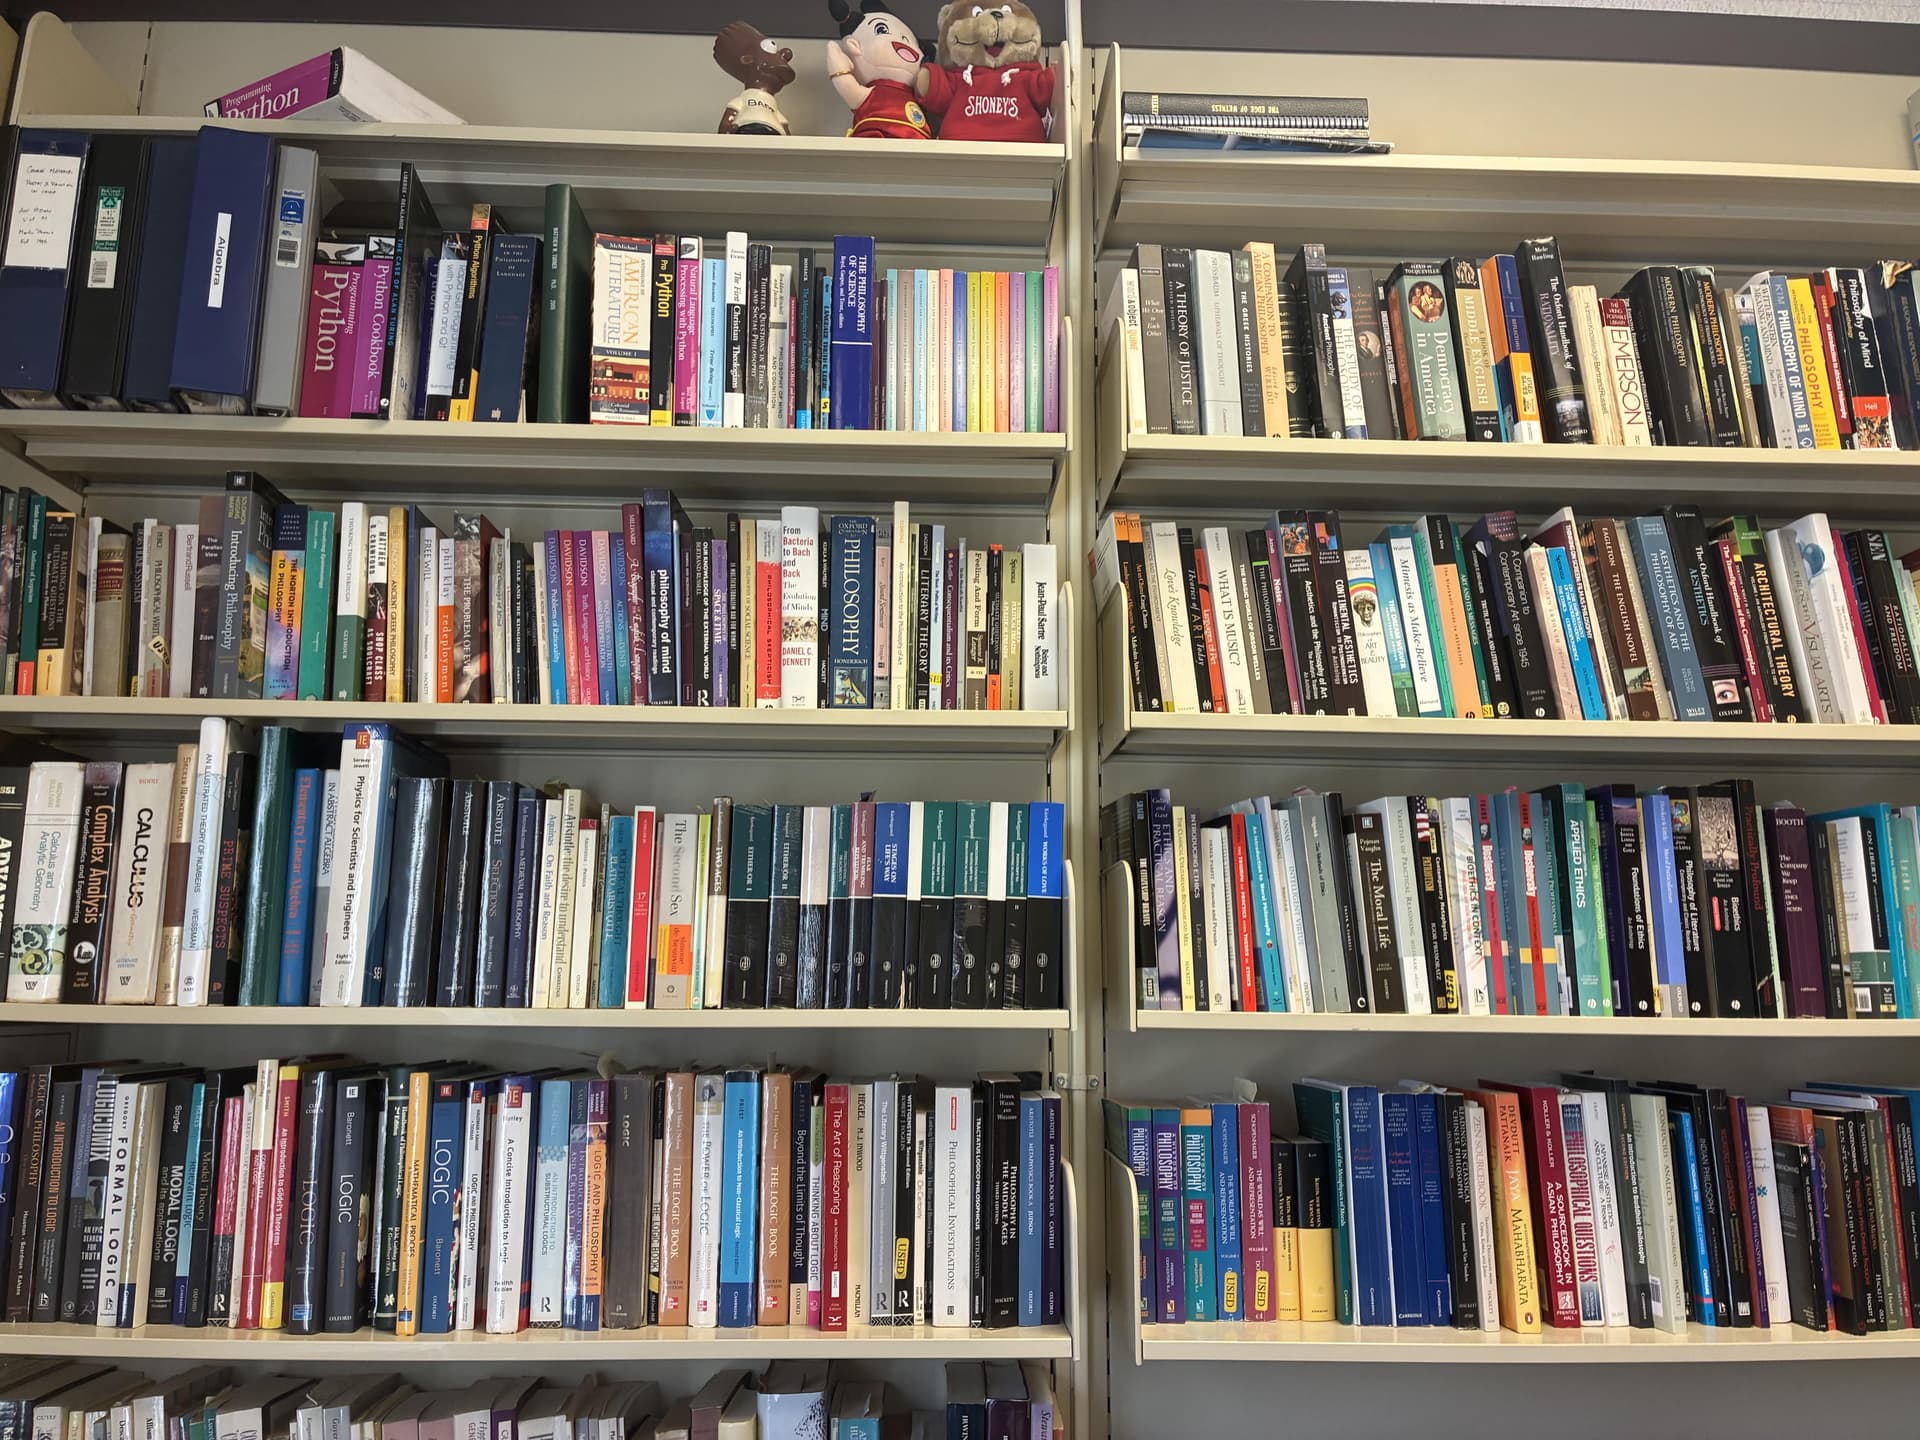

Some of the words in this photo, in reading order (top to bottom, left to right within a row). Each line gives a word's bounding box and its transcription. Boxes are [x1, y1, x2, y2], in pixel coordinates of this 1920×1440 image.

[226, 82, 272, 108] Programming
[965, 95, 1018, 118] SHONEY'S
[1212, 104, 1238, 113] WETNESS
[1239, 105, 1248, 113] OF
[1250, 106, 1266, 114] EDGE
[1267, 106, 1280, 114] THE
[212, 236, 226, 286] Algebra
[473, 235, 483, 259] Python
[848, 255, 856, 268] OF
[858, 255, 866, 274] THE
[394, 256, 402, 276] CASE
[468, 260, 480, 299] Algorithms
[660, 260, 668, 270] Pro
[689, 265, 698, 295] Natural
[374, 264, 390, 310] Python
[392, 279, 400, 289] OF
[607, 254, 622, 344] LITERATURE
[623, 255, 639, 344] AMERICAN
[656, 273, 672, 317] Python
[678, 264, 688, 309] Processing
[847, 270, 856, 307] SCIENCE
[1175, 281, 1185, 289] A
[1550, 277, 1559, 292] The
[345, 271, 360, 335] Programming
[390, 292, 399, 313] ALAN
[688, 297, 697, 335] Language
[857, 276, 866, 333] PHILOSOPHY
[1176, 292, 1188, 338] THEORY
[1553, 294, 1564, 319] Oxford
[1848, 279, 1865, 329] Philosophy
[314, 270, 349, 372] Python
[388, 317, 396, 346] TURING
[679, 311, 687, 330] with
[732, 305, 741, 340] Christian
[1540, 293, 1559, 357] RATIONALITY
[1858, 331, 1867, 341] of
[367, 313, 384, 379] Cookbook
[678, 331, 686, 360] Python
[1179, 341, 1189, 358] OF
[1416, 333, 1428, 347] in
[1464, 295, 1482, 344] MIDDLE
[1473, 349, 1488, 405] ENGLISH
[1558, 321, 1572, 359] Handbook
[1777, 309, 1799, 372] PHILOSOPHY
[1861, 342, 1873, 368] Mind
[731, 345, 740, 388] Theologians
[1178, 360, 1192, 406] JUSTICE
[1419, 352, 1438, 415] America
[1433, 331, 1456, 415] Democracy
[1564, 362, 1575, 371] of
[1611, 329, 1643, 425] EMERSON
[1789, 376, 1802, 388] OF
[1798, 328, 1823, 409] PHILOSOPHY
[1791, 392, 1806, 418] MIND
[783, 526, 801, 535] From
[783, 537, 814, 545] Bacteria
[1601, 527, 1616, 566] EAGLETON
[225, 530, 242, 591] Introducing
[278, 559, 285, 568] TO
[289, 559, 298, 573] THE
[441, 548, 454, 570] phil
[578, 539, 588, 586] DAVIDSON
[783, 548, 791, 556] to
[792, 547, 811, 556] Bach
[783, 558, 796, 567] and
[973, 552, 982, 582] Feeling
[441, 576, 453, 599] klay
[783, 568, 800, 578] Back
[1164, 568, 1178, 594] Love's
[1217, 570, 1232, 607] WHAT
[1399, 559, 1413, 600] Mimesis
[1611, 573, 1622, 591] THE
[275, 573, 284, 623] PHILOSOPHY
[287, 575, 297, 608] NORTON
[657, 570, 670, 630] philosophy
[841, 538, 860, 656] PHILOSOPHY
[920, 570, 930, 622] LITERARY
[1035, 581, 1047, 616] Jean-Paul
[1407, 602, 1415, 614] as
[220, 592, 239, 650] Philosophy
[1038, 617, 1046, 640] Sartre
[1168, 596, 1184, 647] Knowledge
[1222, 609, 1234, 620] IS
[1615, 592, 1631, 631] ENGLISH
[283, 610, 295, 671] INTRODUCTION
[660, 632, 671, 644] of
[1224, 622, 1240, 666] MUSIC?
[1753, 562, 1784, 650] ARCHITECTURAL
[1774, 654, 1795, 697] THEORY
[440, 615, 451, 694] redeployment
[661, 646, 671, 673] mind
[782, 647, 806, 656] DANIEL
[807, 647, 813, 655] C.
[782, 657, 811, 666] DENNETT
[919, 627, 928, 674] THEORY
[1409, 615, 1428, 683] Make-Believe
[1625, 633, 1638, 664] NOVEL
[353, 776, 366, 808] Physics
[90, 804, 115, 862] Complex
[353, 811, 362, 825] for
[674, 820, 687, 844] The
[36, 831, 49, 866] Analytic
[46, 831, 62, 868] Calculus
[348, 827, 361, 870] Scientists
[1569, 820, 1583, 865] APPLIED
[45, 871, 56, 889] and
[347, 873, 357, 891] and
[671, 846, 684, 892] Second
[1369, 859, 1383, 883] The
[30, 868, 46, 912] Geometry
[84, 868, 107, 924] Analysis
[669, 894, 682, 917] Sex
[1373, 885, 1386, 922] Moral
[1575, 868, 1586, 908] ETHICS
[342, 893, 355, 940] Engineers
[1377, 926, 1391, 949] Life
[345, 1112, 355, 1145] Baronett
[832, 1109, 842, 1129] The
[795, 1129, 806, 1164] Beyond
[832, 1147, 843, 1158] of
[833, 1131, 842, 1145] Art
[111, 1137, 128, 1215] FORMAL
[432, 1138, 452, 1205] LOGIC
[593, 1150, 602, 1181] LOGIC
[797, 1166, 805, 1182] the
[947, 1141, 959, 1212] PHILOSOPHICAL
[1186, 1134, 1202, 1192] PHILOSOPHY
[1564, 1130, 1587, 1219] PHILOSOPHICAL
[167, 1166, 183, 1215] MODAL
[338, 1174, 353, 1224] LOGIC
[592, 1184, 601, 1205] AND
[796, 1184, 806, 1211] Limits
[830, 1160, 842, 1215] Reasoning
[1546, 1181, 1557, 1215] ASIAN
[796, 1214, 805, 1224] of
[105, 1228, 120, 1288] LOGIC
[163, 1220, 178, 1262] LOGIC
[590, 1208, 600, 1273] PHILOSOPHY
[793, 1226, 805, 1268] Thought
[947, 1215, 957, 1290] INVESTIGATIONS
[1511, 1208, 1529, 1306] MAHABHARATA
[1549, 1218, 1564, 1286] PHILOSOPHY
[1575, 1222, 1598, 1283] QUESTIONS
[1257, 1276, 1266, 1307] USED
